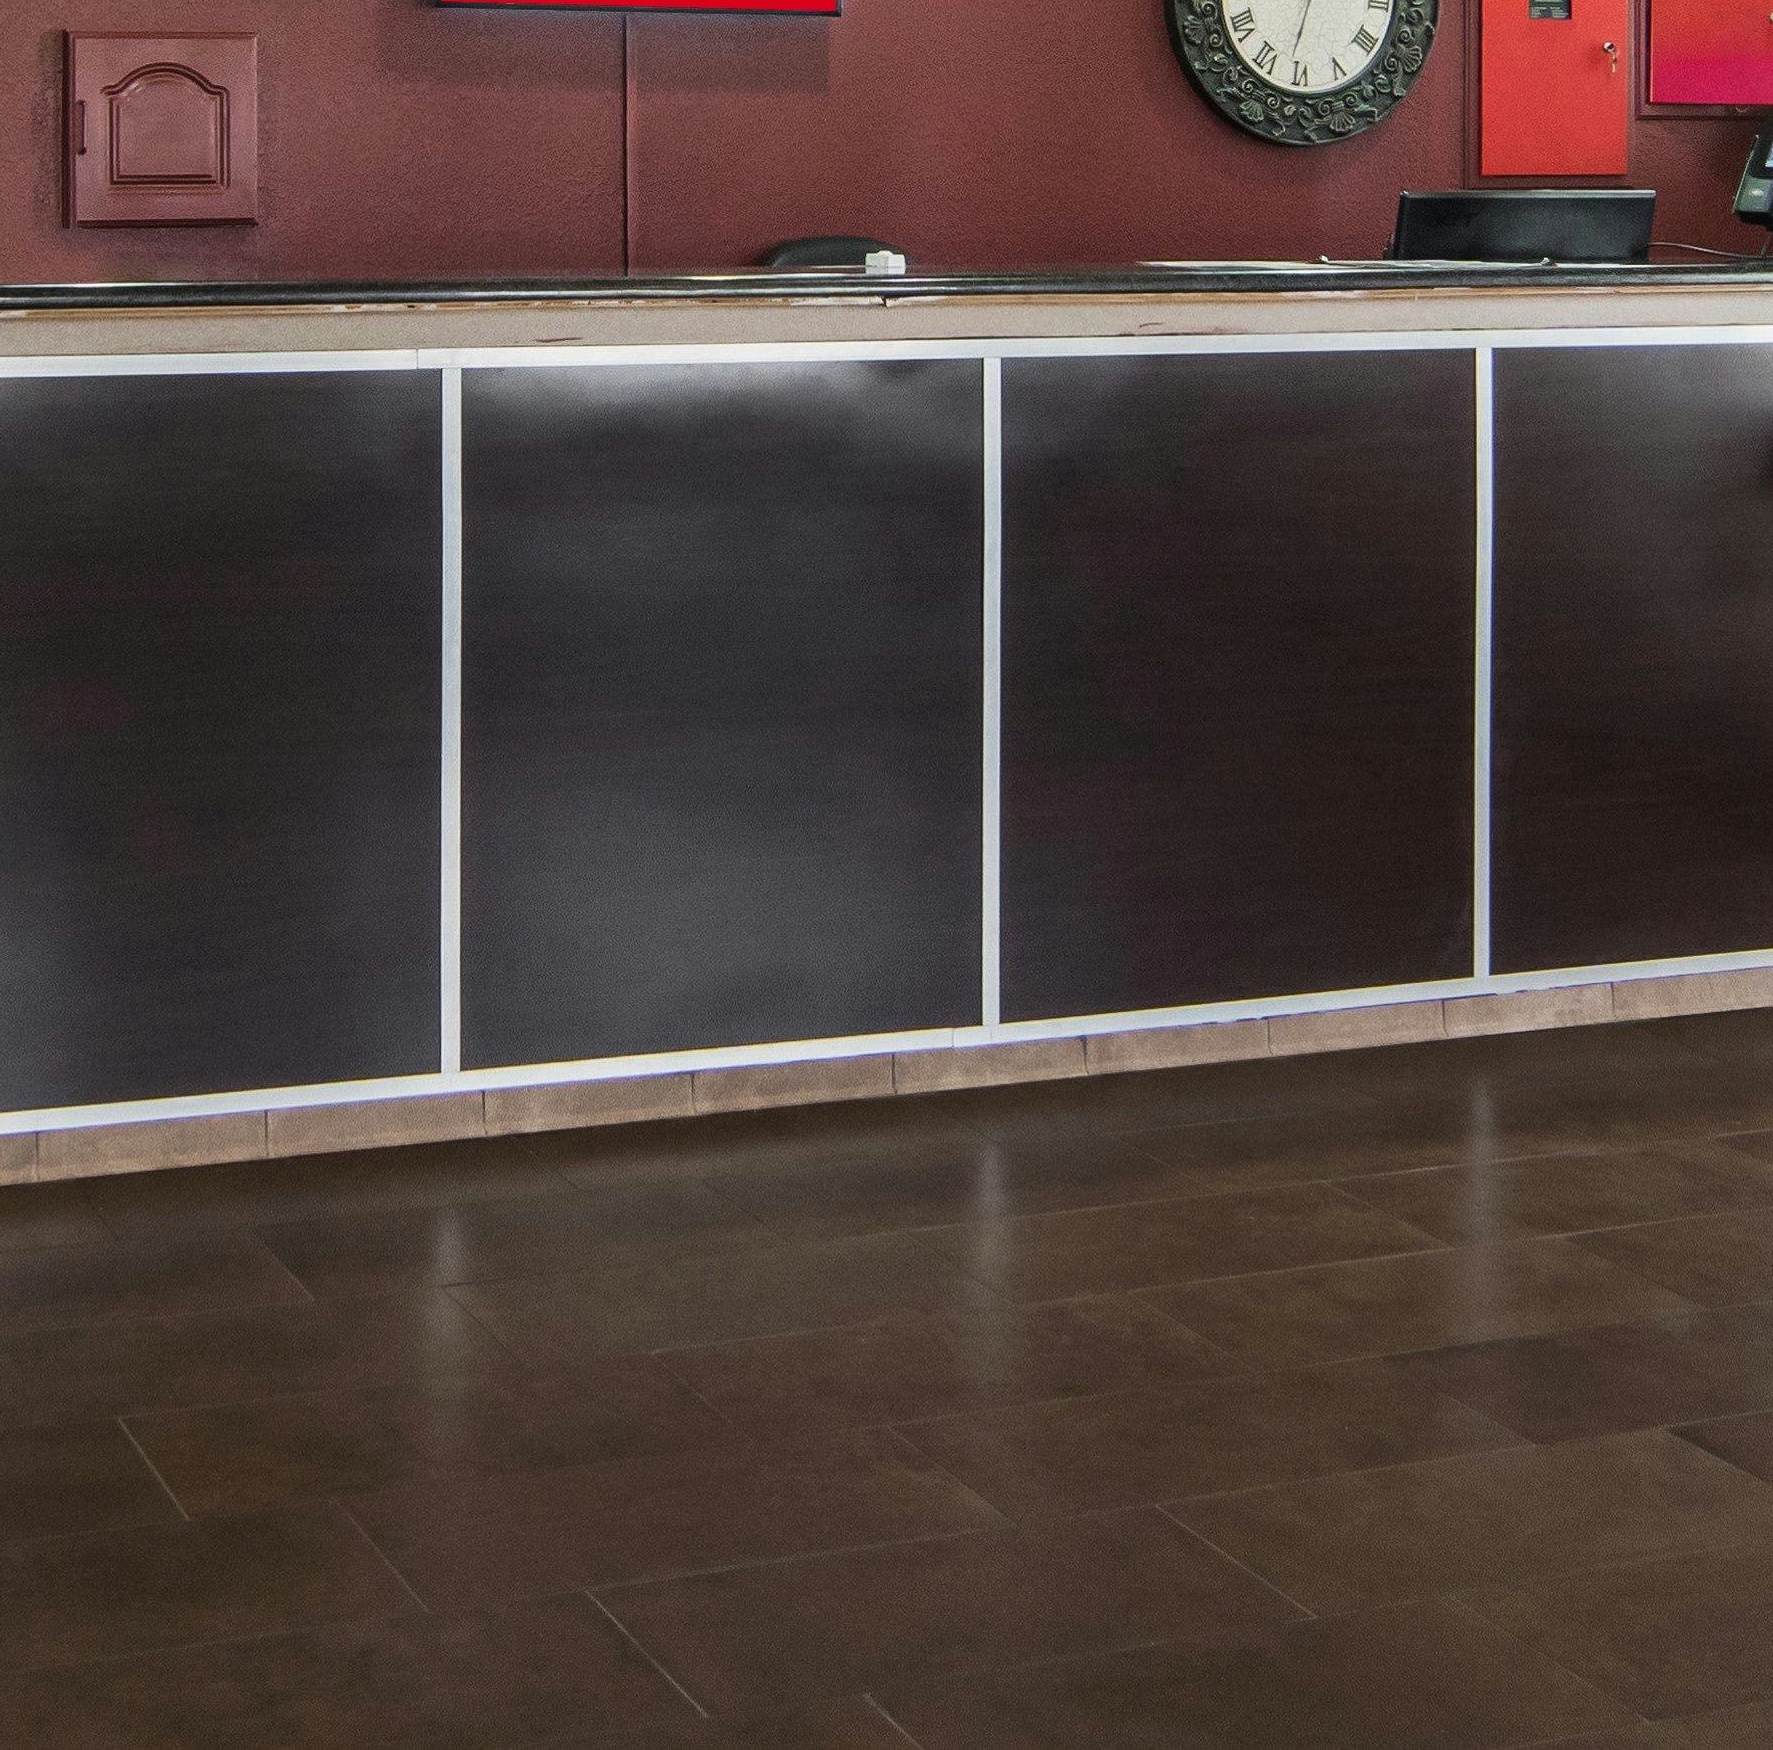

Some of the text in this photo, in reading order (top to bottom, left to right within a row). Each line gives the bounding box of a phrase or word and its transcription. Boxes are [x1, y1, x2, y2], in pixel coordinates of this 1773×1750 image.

[1231, 9, 1256, 42] VIII
[1252, 41, 1278, 75] VII
[1331, 56, 1347, 81] V
[1292, 60, 1308, 86] VI
